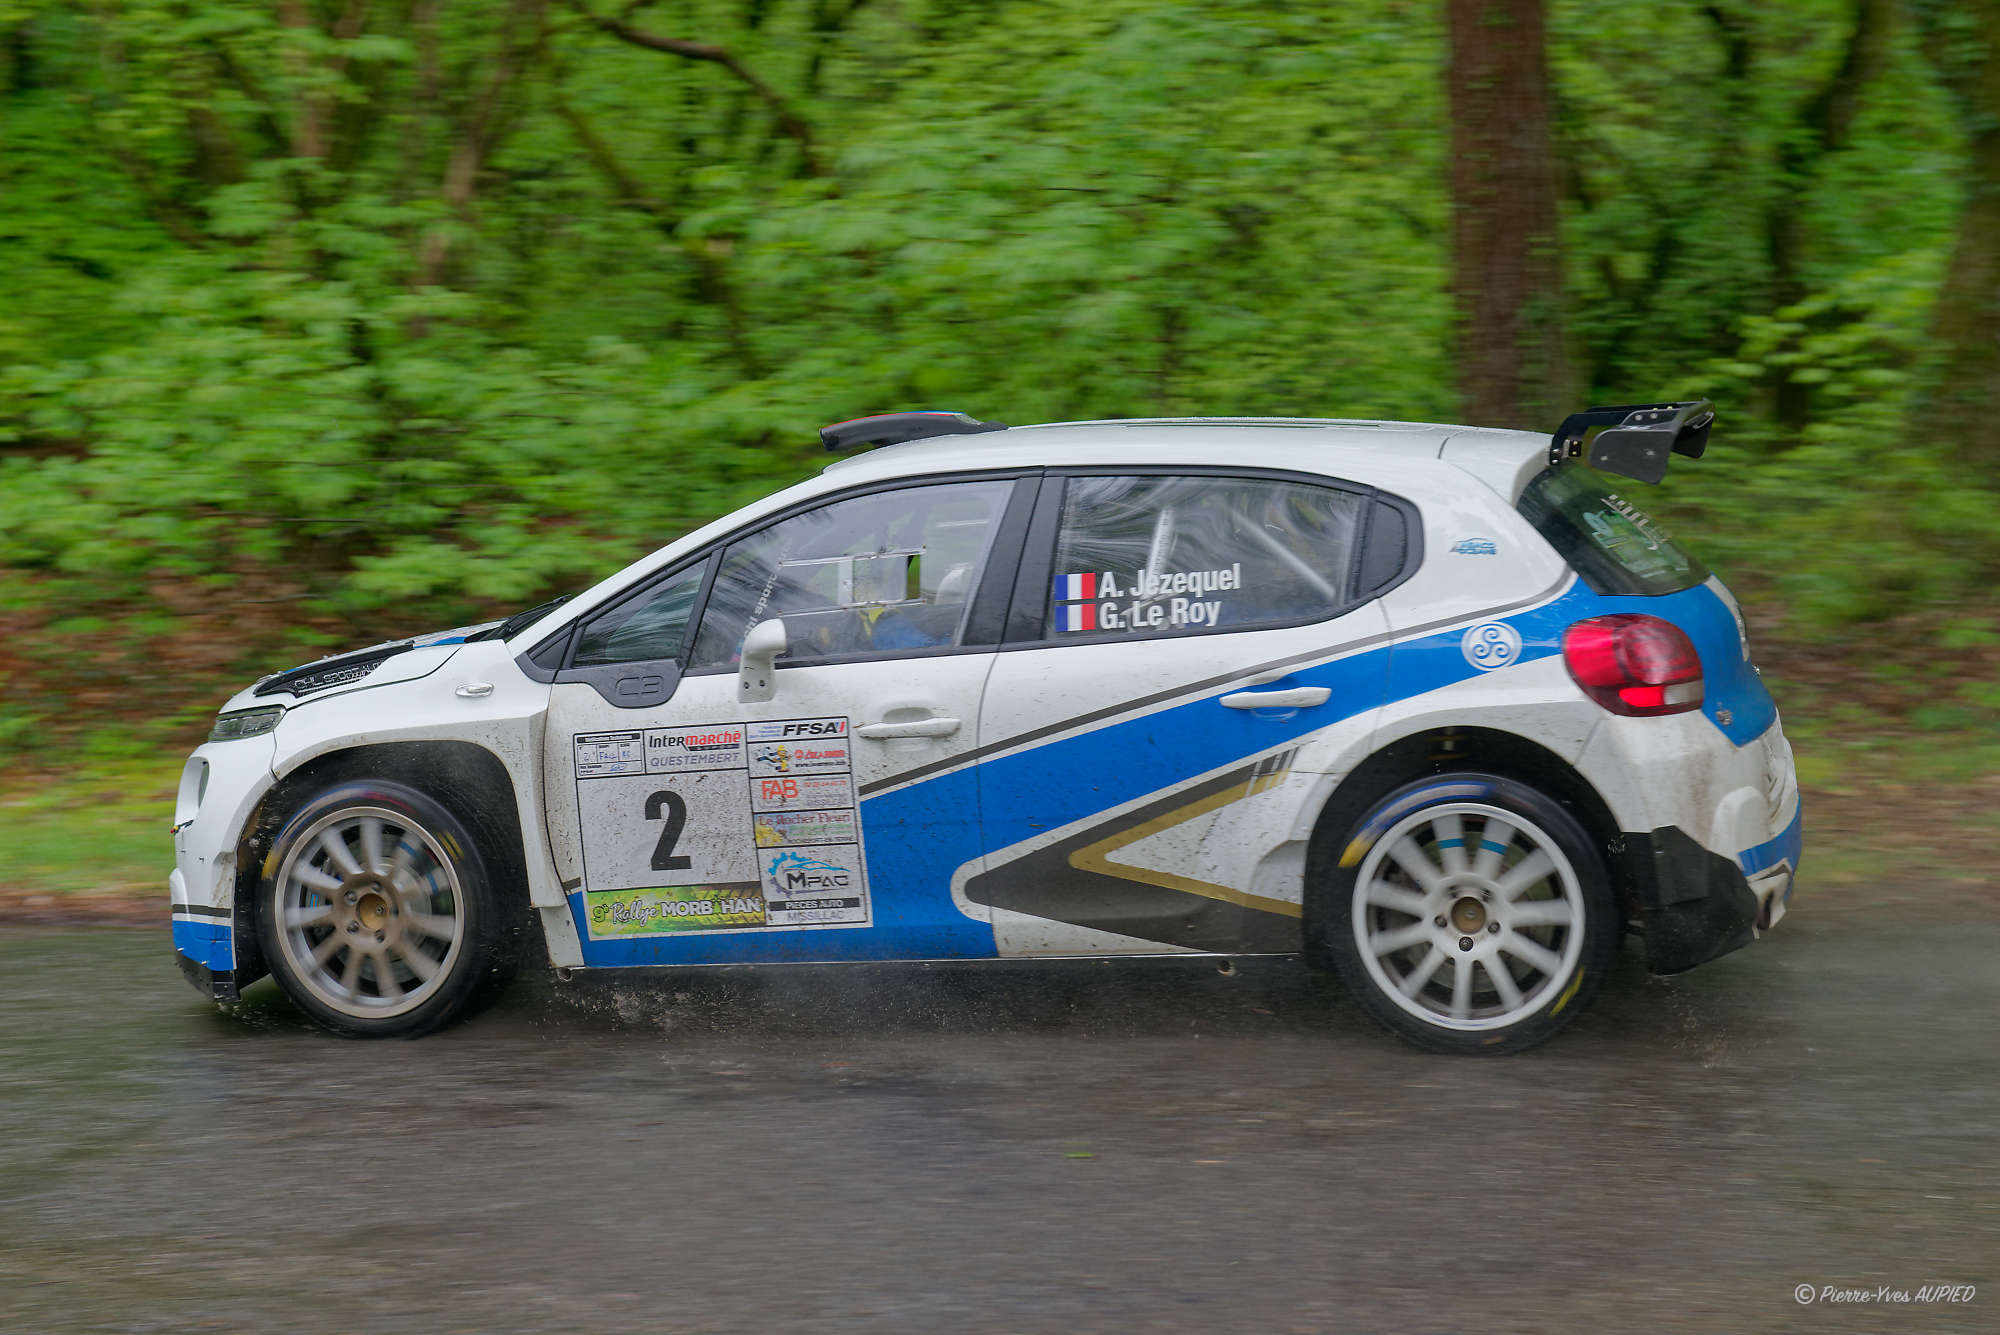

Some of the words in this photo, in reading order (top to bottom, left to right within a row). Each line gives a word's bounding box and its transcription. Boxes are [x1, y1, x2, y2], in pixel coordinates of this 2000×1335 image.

[1098, 571, 1125, 599] A.
[1129, 563, 1241, 598] Jezequel
[754, 572, 778, 616] sport
[1100, 602, 1126, 630] G.
[1132, 601, 1164, 627] Le
[1171, 597, 1222, 627] Roy
[615, 675, 664, 695] C3
[782, 721, 838, 737] FFSA
[650, 753, 740, 767] QUESTEMBERT
[761, 779, 799, 800] FAB
[645, 790, 692, 871] 2
[787, 872, 849, 890] MPAC
[611, 900, 659, 927] Rallye
[819, 899, 845, 909] AUTO
